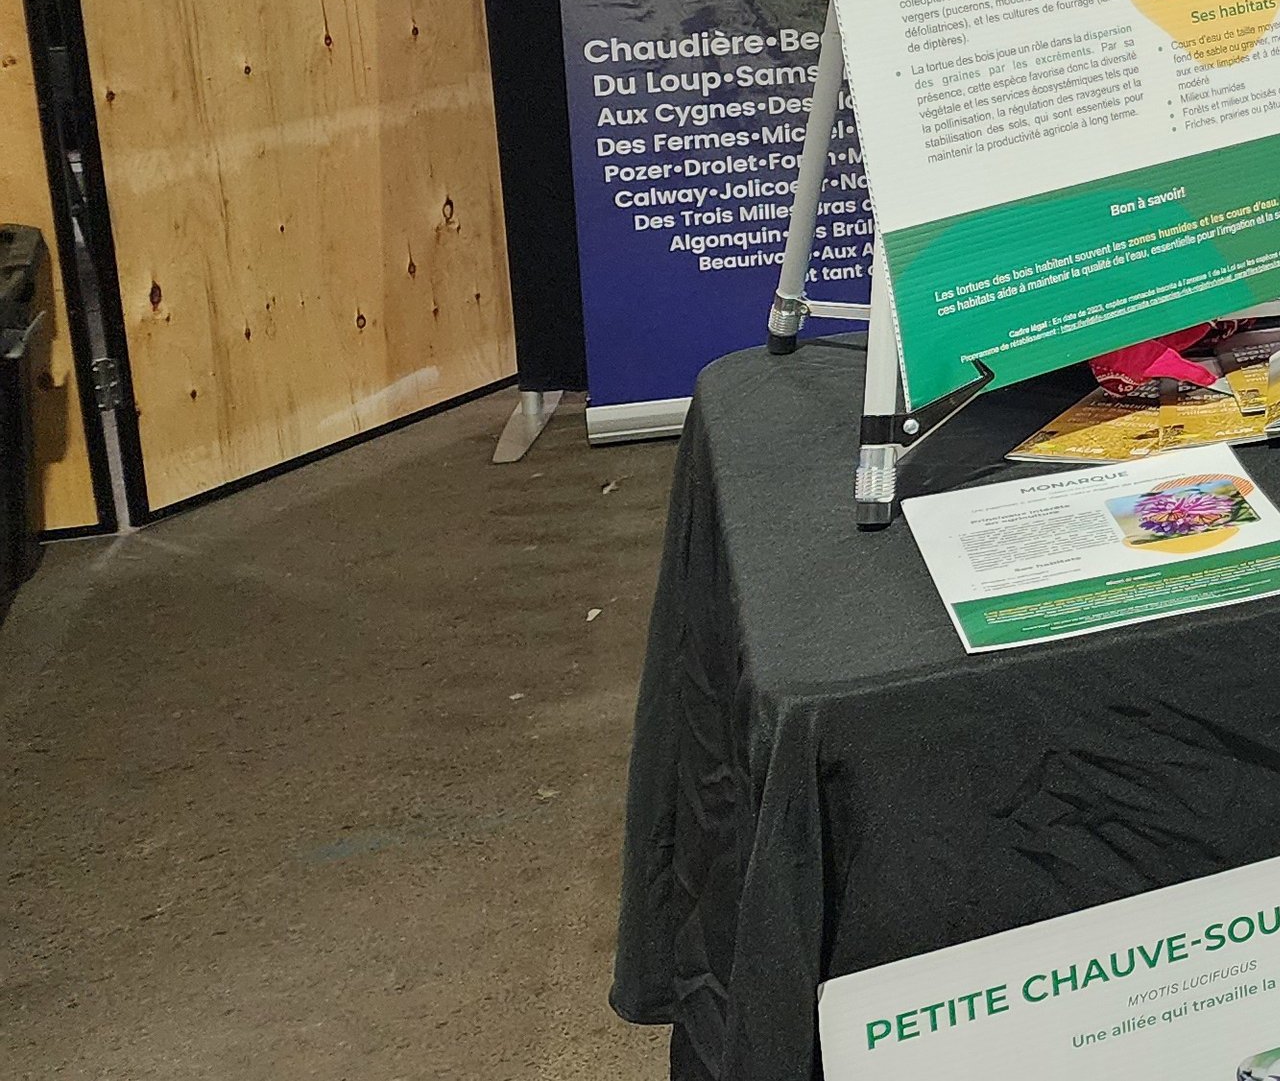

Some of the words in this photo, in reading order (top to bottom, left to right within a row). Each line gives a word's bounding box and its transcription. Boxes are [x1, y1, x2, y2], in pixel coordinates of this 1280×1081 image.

[1191, 10, 1216, 23] Ses
[593, 74, 636, 96] Du
[597, 107, 648, 126] Aux
[597, 138, 645, 156] Des
[1110, 202, 1135, 216] Bon
[1137, 197, 1146, 209] à
[1147, 186, 1185, 206] savoir!
[634, 214, 675, 230] Des
[680, 206, 733, 226] Trois
[1020, 470, 1129, 494] MONARQUE
[1127, 982, 1178, 1007] MYOTIS
[1182, 959, 1257, 990] LUCIFUGUS
[866, 983, 1009, 1050] PETITE
[1072, 1030, 1107, 1047] Une
[1112, 1014, 1156, 1036] alliée
[1161, 1001, 1187, 1023] qui
[1192, 984, 1257, 1011] travaille
[1262, 978, 1275, 991] la
